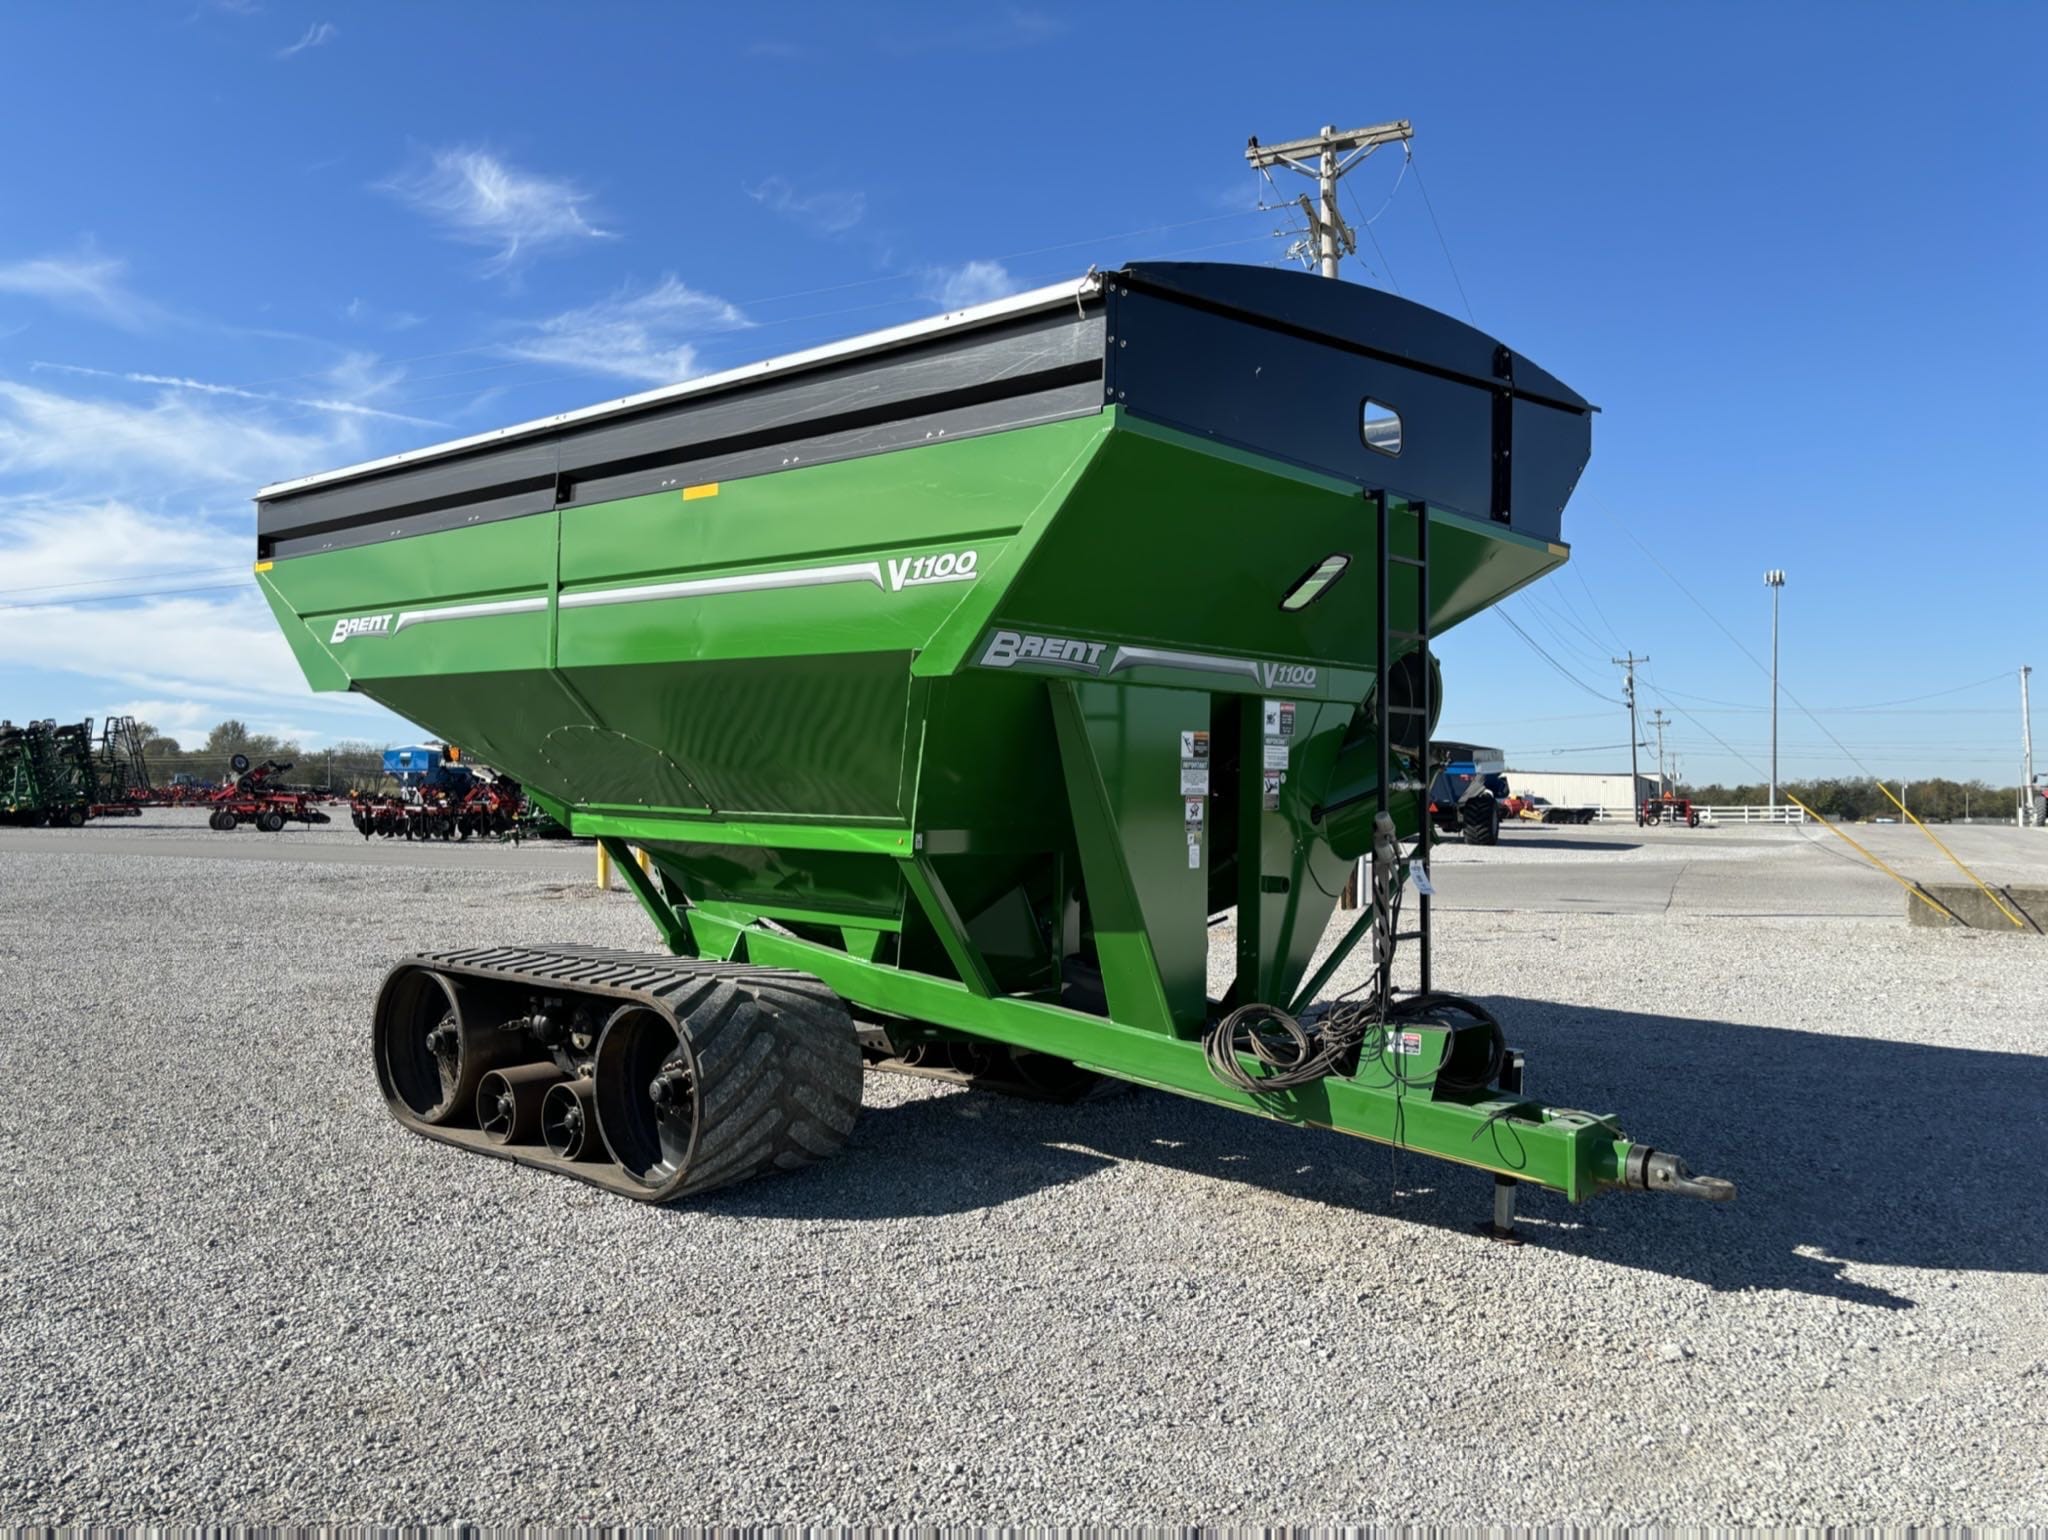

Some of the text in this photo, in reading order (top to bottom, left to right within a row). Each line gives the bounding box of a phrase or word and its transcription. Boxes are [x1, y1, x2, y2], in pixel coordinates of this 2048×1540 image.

[887, 550, 978, 592] V1100
[330, 613, 393, 644] BRENT
[980, 631, 1107, 668] BRENT
[1263, 662, 1317, 689] V1100
